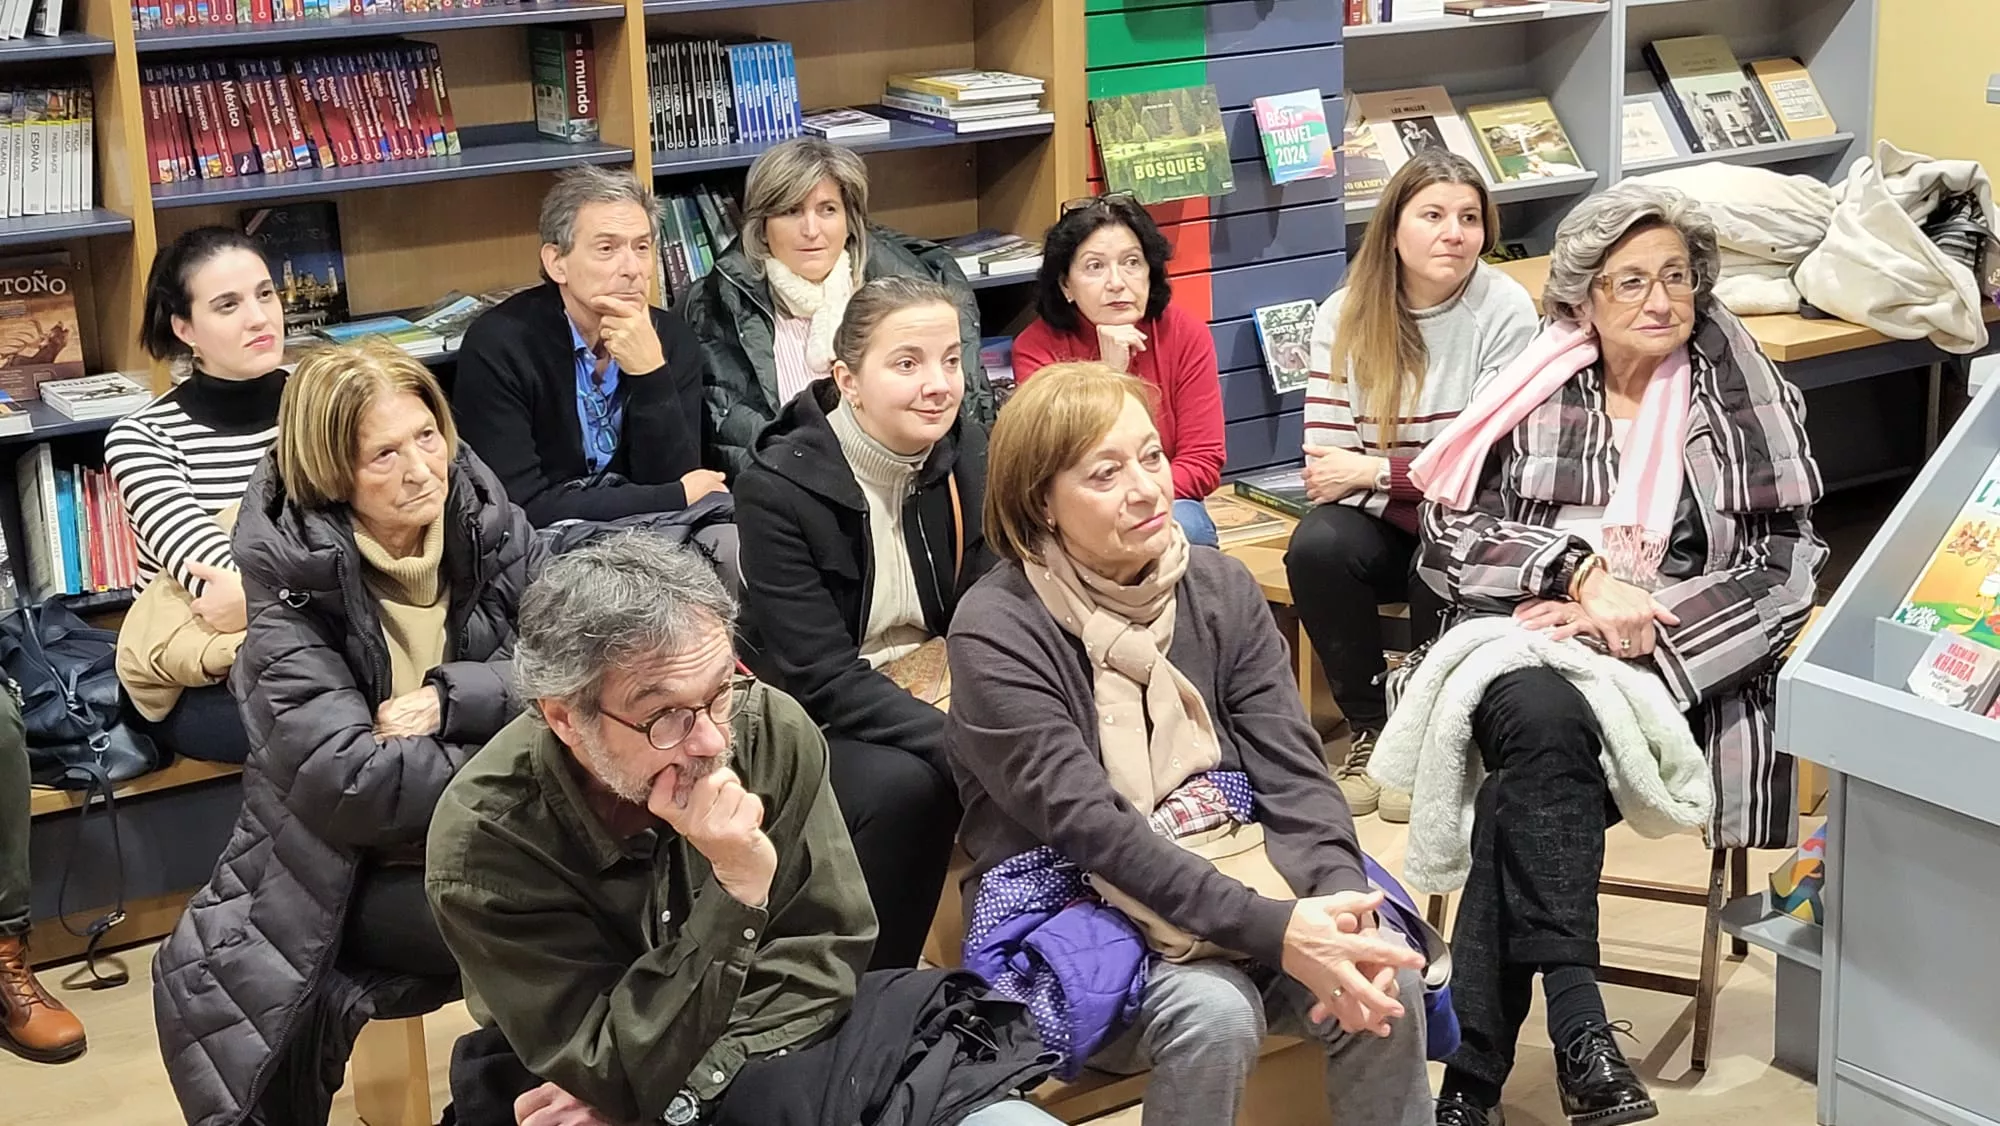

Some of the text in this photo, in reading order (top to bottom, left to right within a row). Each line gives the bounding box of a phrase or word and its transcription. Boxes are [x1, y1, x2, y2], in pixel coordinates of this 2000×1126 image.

[316, 77, 329, 102] Perú
[327, 76, 340, 108] Polonia
[434, 65, 446, 98] Vietnam
[575, 60, 590, 114] mundo
[193, 85, 209, 131] Marruecos
[221, 81, 240, 127] México
[264, 80, 275, 106] Nueva
[271, 106, 281, 125] York
[278, 79, 301, 141] Nueva Zelanda
[1266, 109, 1295, 128] BEST
[1271, 125, 1312, 146] TRAVEL
[30, 132, 41, 173] ESPAÑA
[1133, 157, 1206, 180] BOSQUES
[1275, 144, 1308, 167] 2024
[1933, 653, 1976, 682] KHADRA
